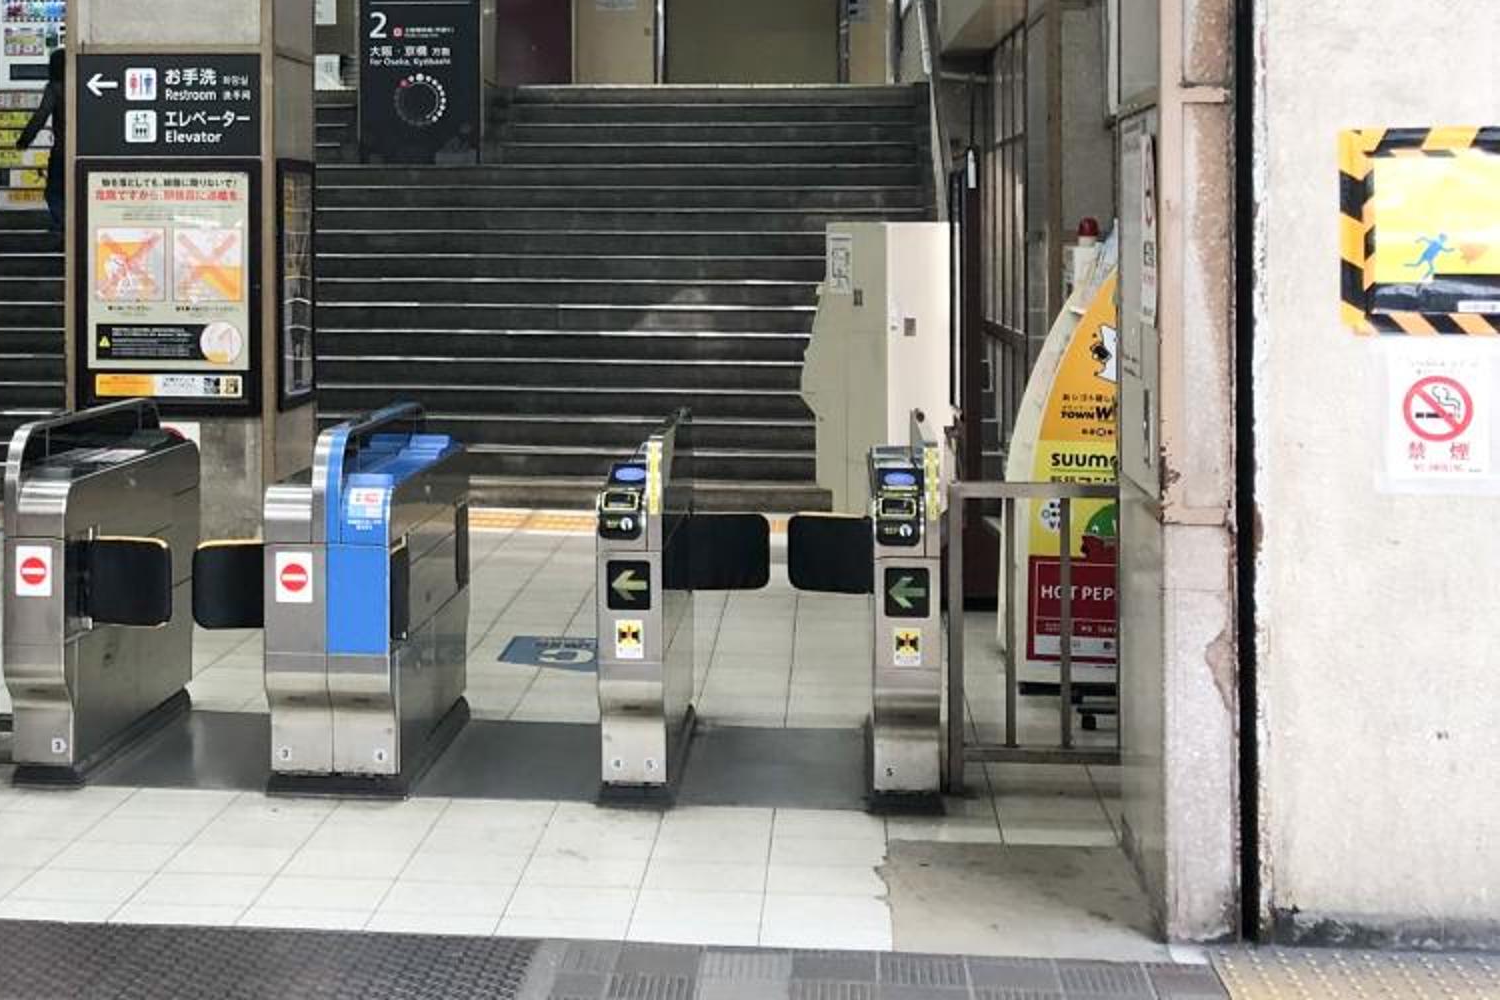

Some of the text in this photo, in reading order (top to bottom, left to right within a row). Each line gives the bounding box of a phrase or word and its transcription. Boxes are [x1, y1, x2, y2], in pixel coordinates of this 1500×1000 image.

[369, 12, 387, 38] 2
[164, 68, 217, 86] お手洗
[165, 88, 217, 101] Restroom
[165, 110, 251, 127] エレベーター
[165, 130, 222, 144] Elevator
